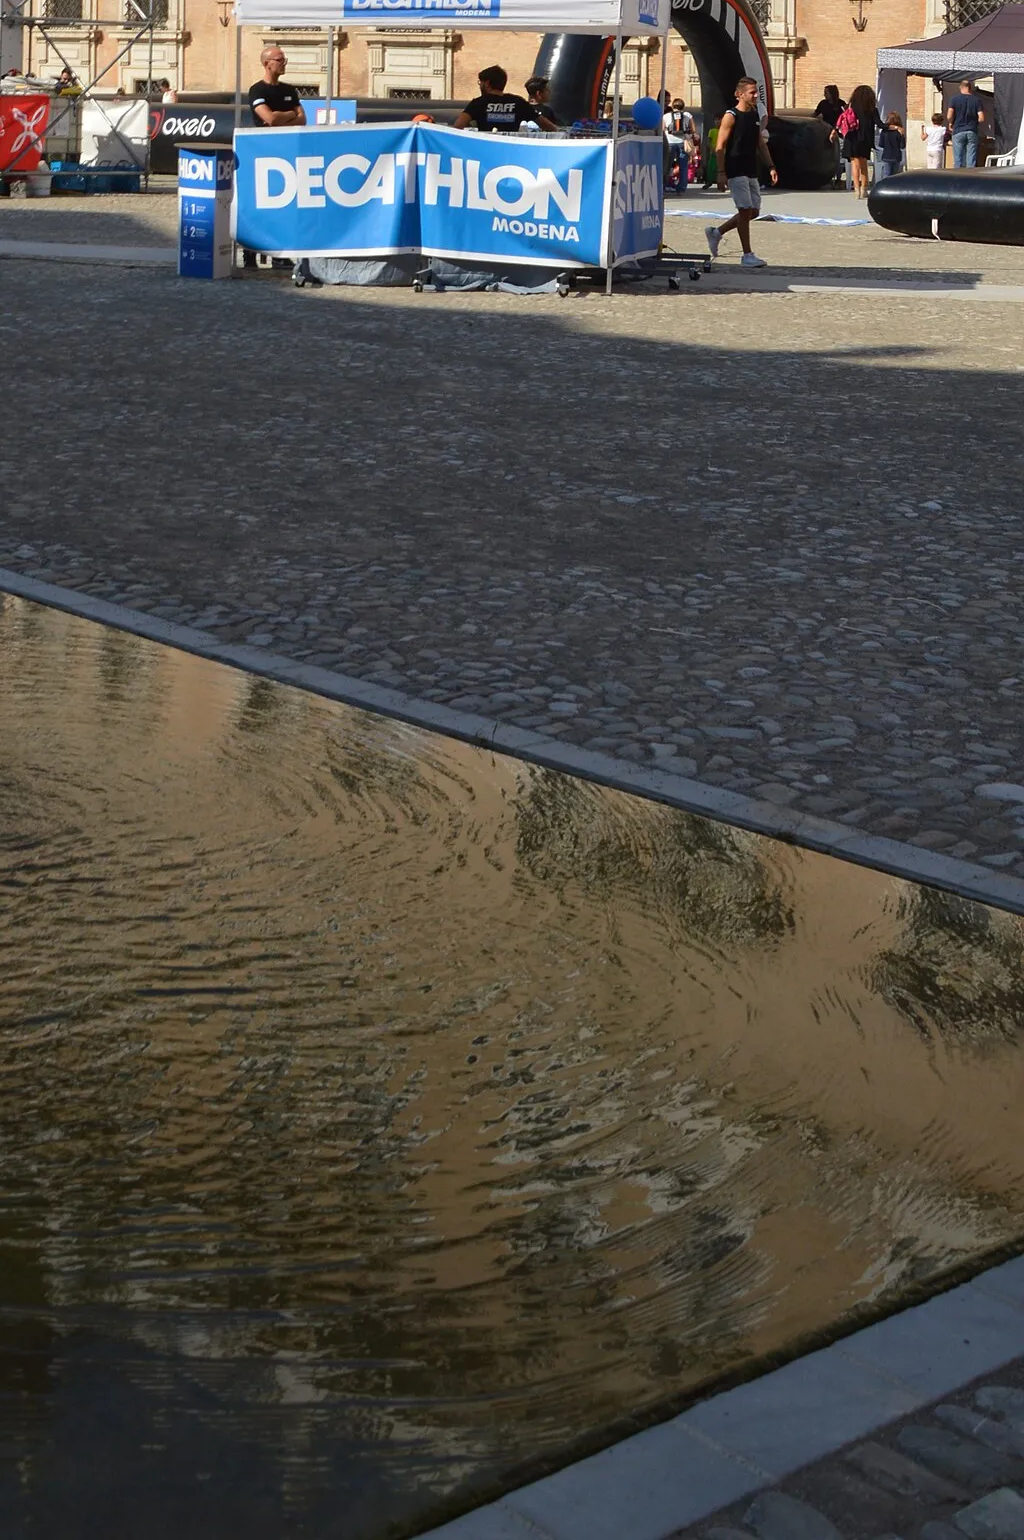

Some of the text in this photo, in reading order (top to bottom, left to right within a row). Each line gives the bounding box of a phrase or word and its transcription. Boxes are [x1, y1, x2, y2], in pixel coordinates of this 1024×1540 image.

[455, 9, 491, 17] MODENA
[486, 103, 515, 112] STAFF
[162, 115, 216, 137] oxelo
[254, 152, 584, 223] DECATHLON
[492, 216, 580, 242] MODENA
